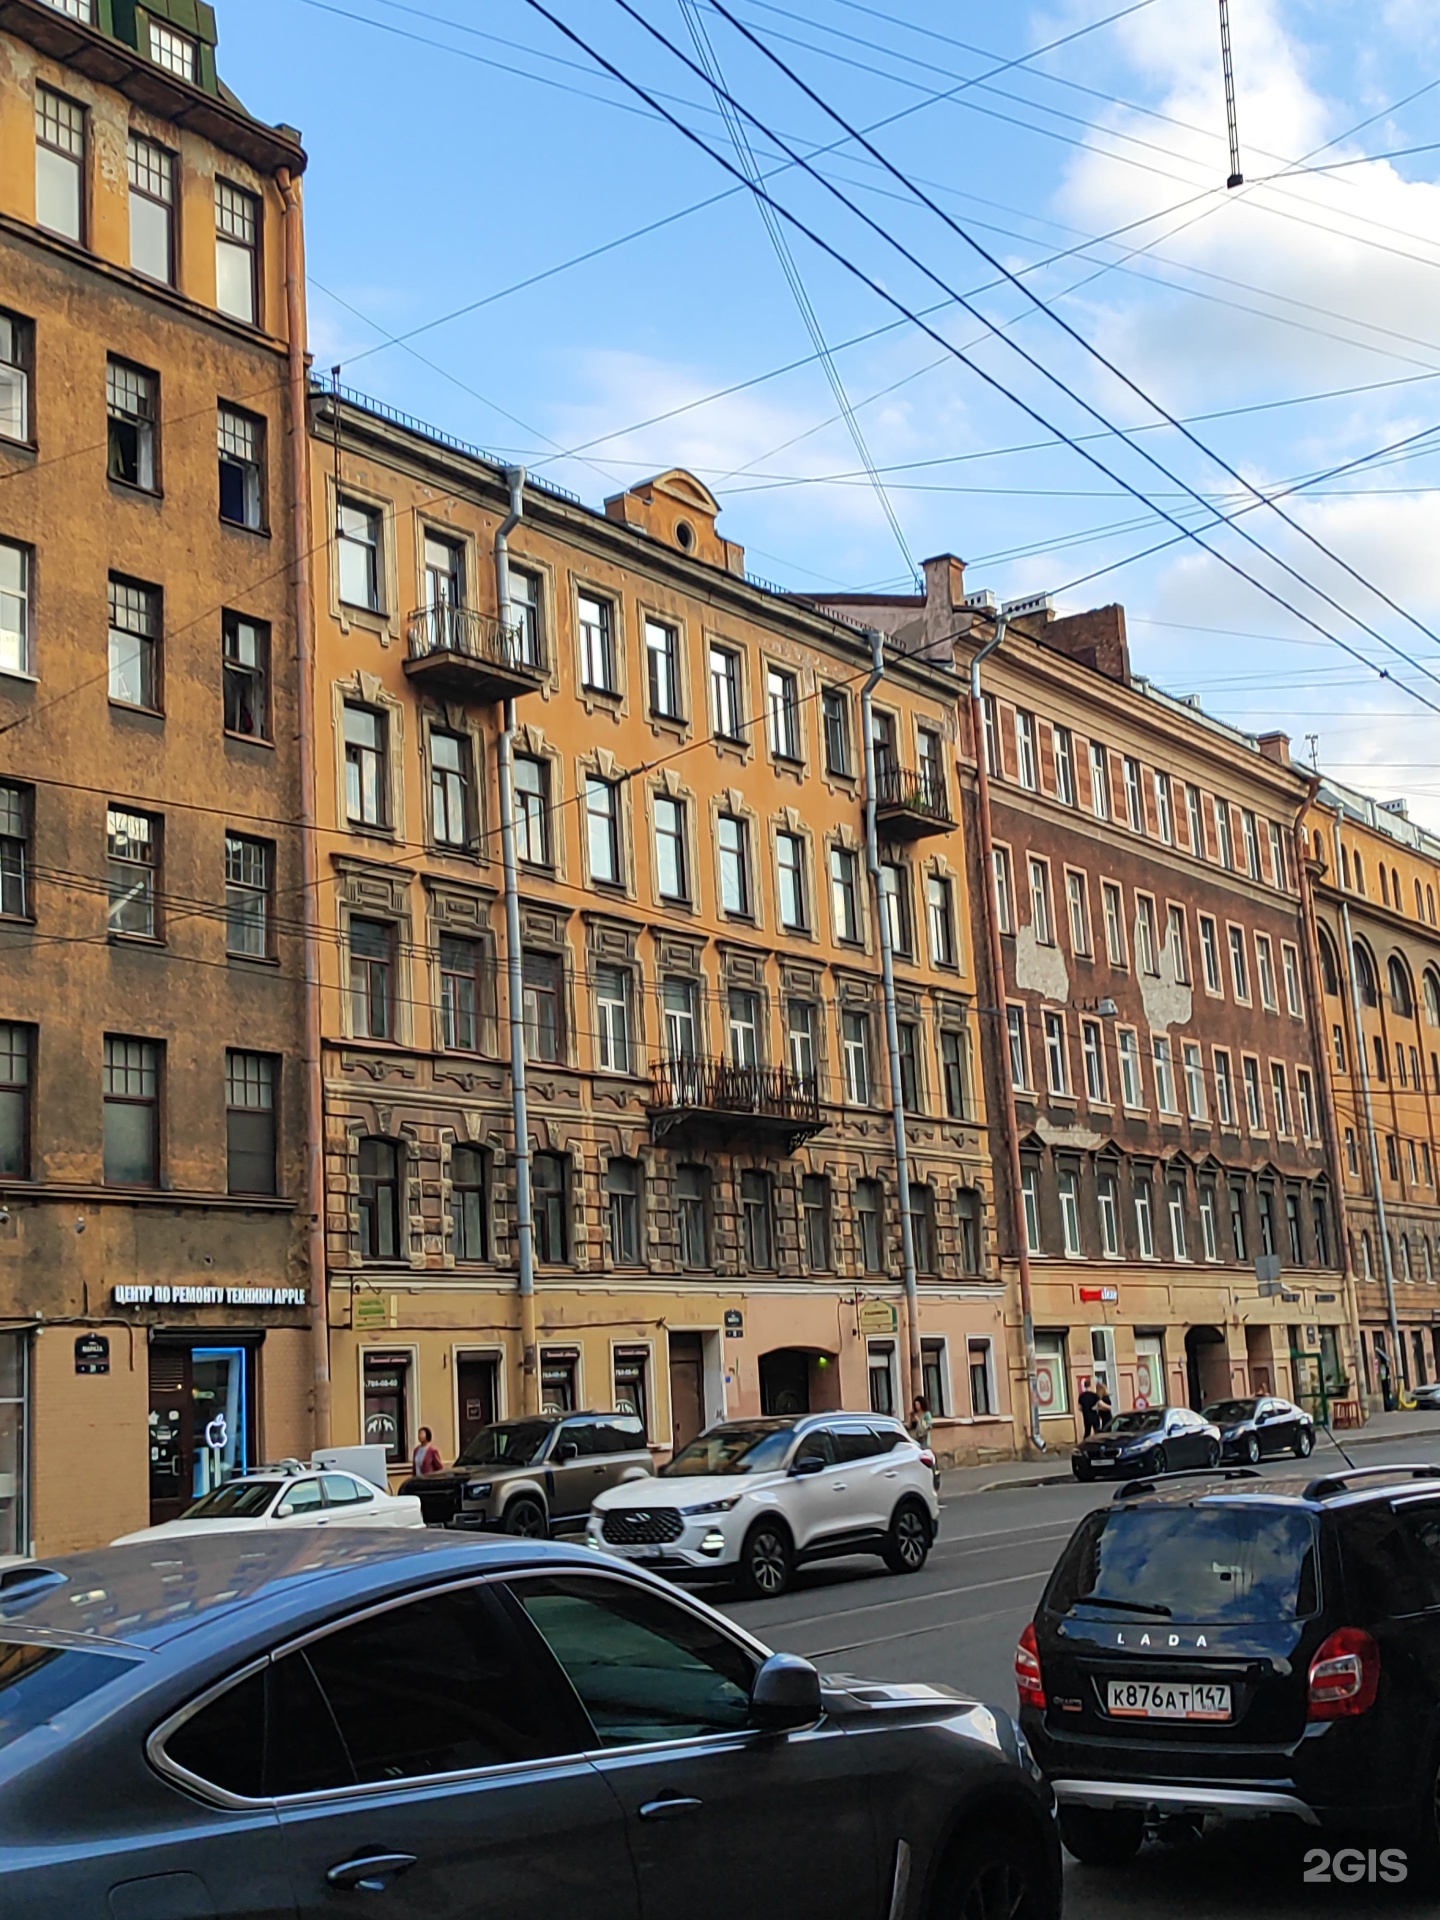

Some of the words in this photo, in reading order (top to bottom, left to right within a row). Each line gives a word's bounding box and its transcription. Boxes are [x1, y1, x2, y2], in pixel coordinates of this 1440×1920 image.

[115, 1285, 153, 1304] ЦЕНТР
[154, 1286, 171, 1303] ПО
[172, 1286, 225, 1304] РЕМОНТУ
[226, 1287, 273, 1304] ТЕХНИКИ
[274, 1288, 306, 1305] APPLE
[1117, 1632, 1207, 1647] LADA
[1195, 1687, 1226, 1707] 147
